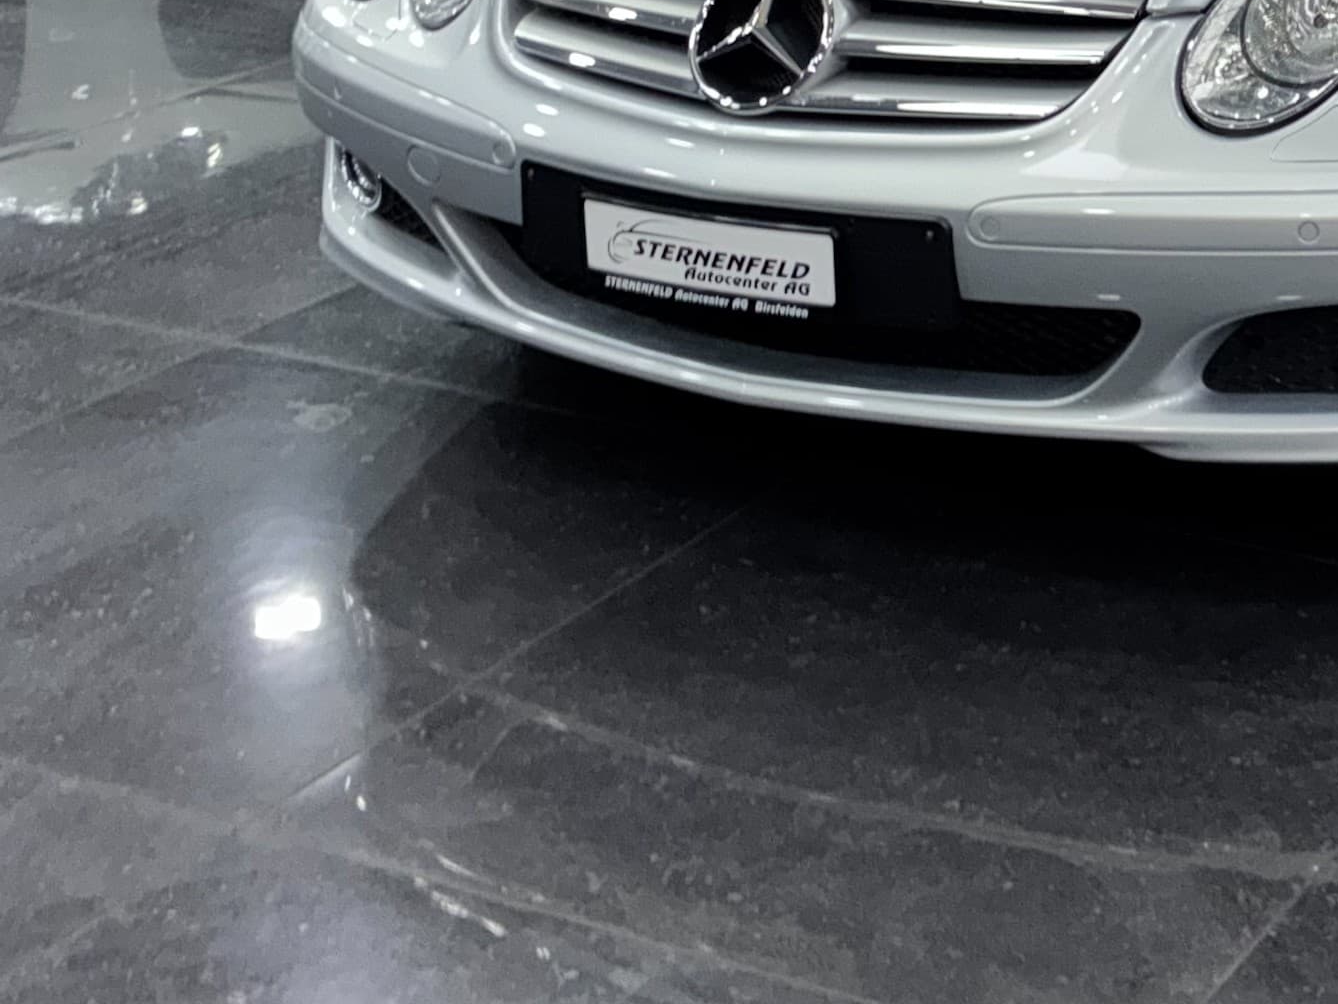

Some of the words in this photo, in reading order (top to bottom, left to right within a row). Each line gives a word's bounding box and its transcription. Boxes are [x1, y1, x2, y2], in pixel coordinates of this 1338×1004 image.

[634, 239, 810, 279] STERNENFELD
[604, 275, 673, 299] STERNENFELD
[674, 289, 730, 309] Autocenter
[732, 297, 749, 311] AG
[684, 267, 778, 292] Autocenter
[784, 281, 810, 296] AG
